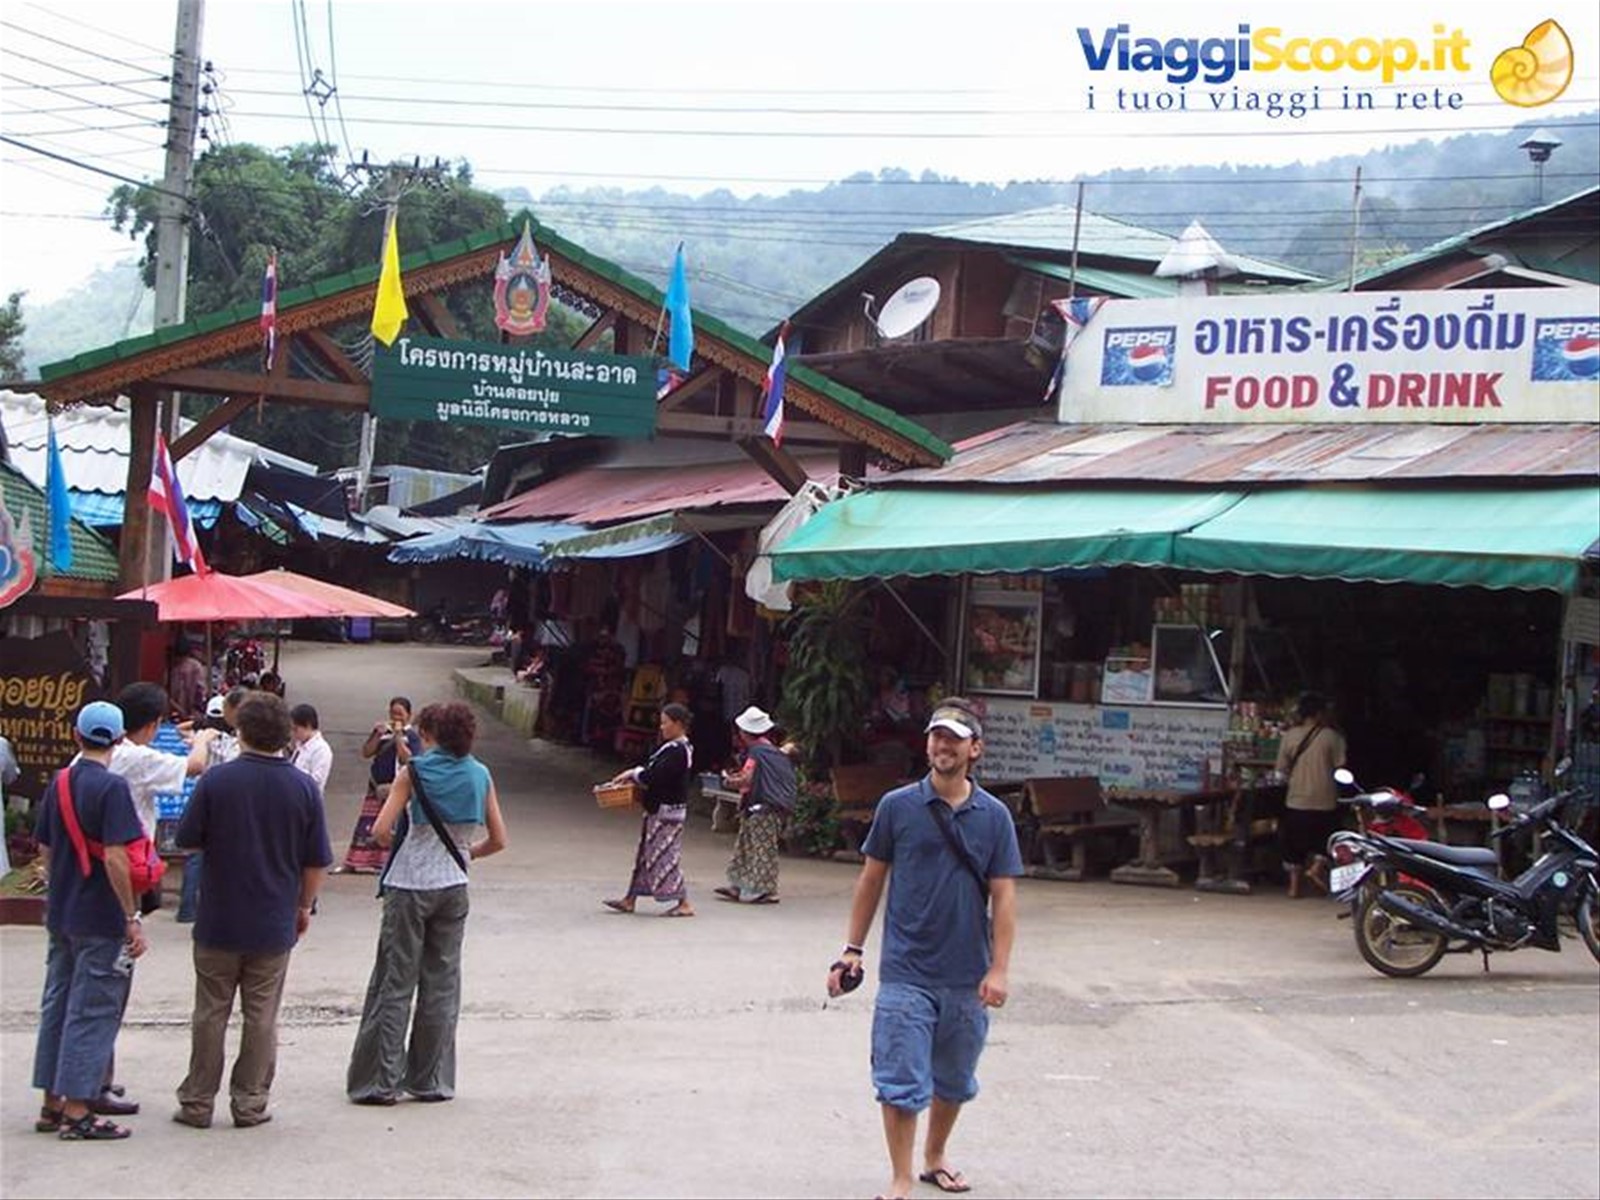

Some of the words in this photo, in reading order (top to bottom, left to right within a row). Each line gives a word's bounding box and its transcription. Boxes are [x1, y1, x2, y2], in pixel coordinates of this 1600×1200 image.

[1107, 331, 1172, 349] PEPSI
[1194, 294, 1526, 355] อาหาร-เครื่องดื่ม
[399, 338, 638, 384] โครงการหมู่บ้านสะอาด
[472, 378, 560, 409] บ้านดอยปุย
[1204, 374, 1320, 410] FOOD
[1328, 362, 1361, 408] &
[1366, 372, 1504, 409] DRINK
